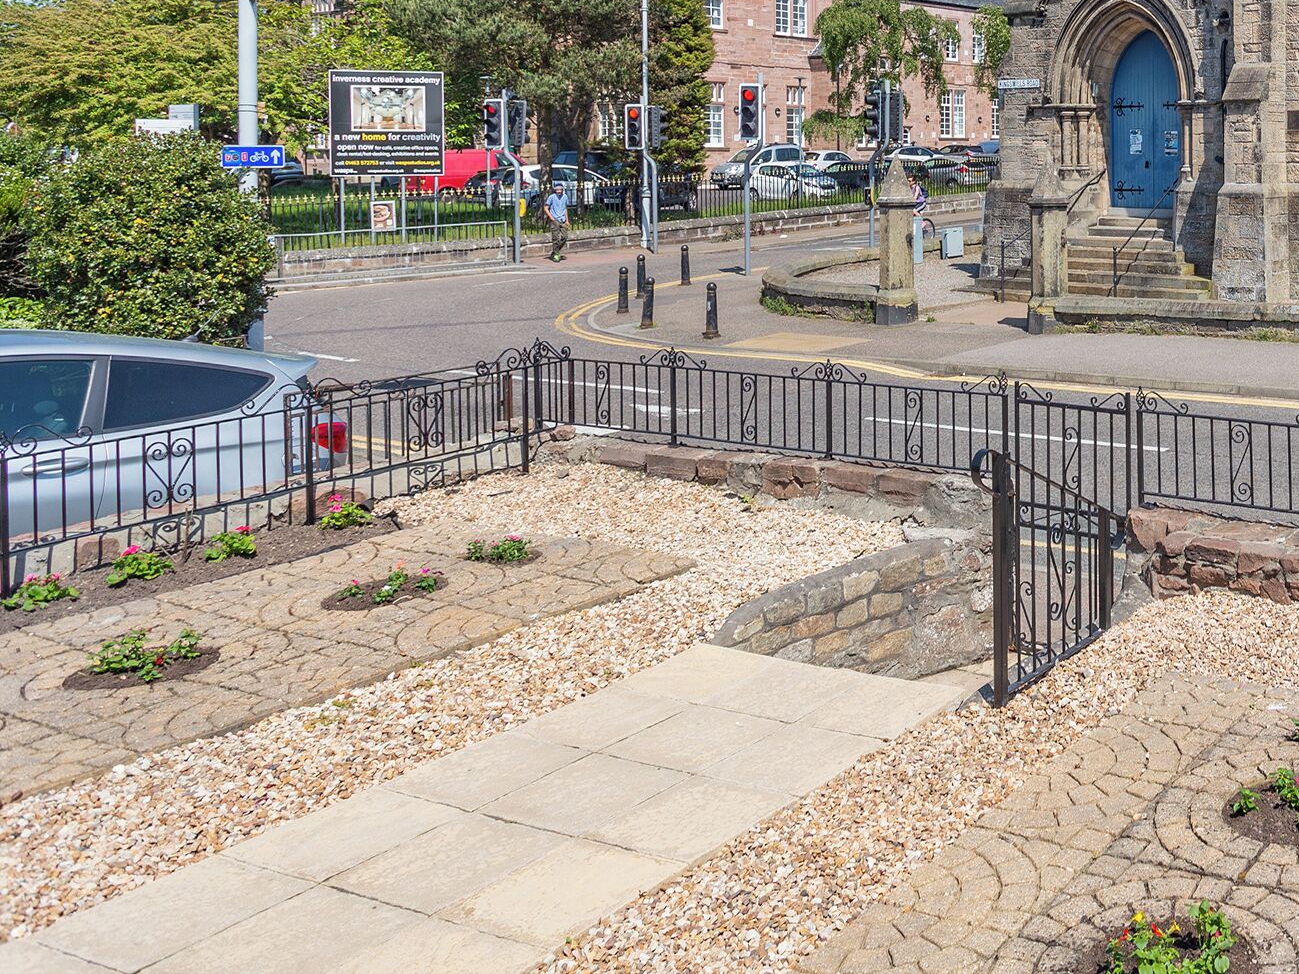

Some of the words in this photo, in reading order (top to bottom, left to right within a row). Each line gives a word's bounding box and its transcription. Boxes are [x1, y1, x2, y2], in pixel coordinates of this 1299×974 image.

[332, 74, 371, 83] inverness
[372, 75, 404, 83] creative
[405, 76, 441, 85] academy
[1026, 79, 1039, 87] ROAD
[362, 133, 387, 141] home
[387, 133, 401, 141] for
[402, 133, 441, 143] creativity
